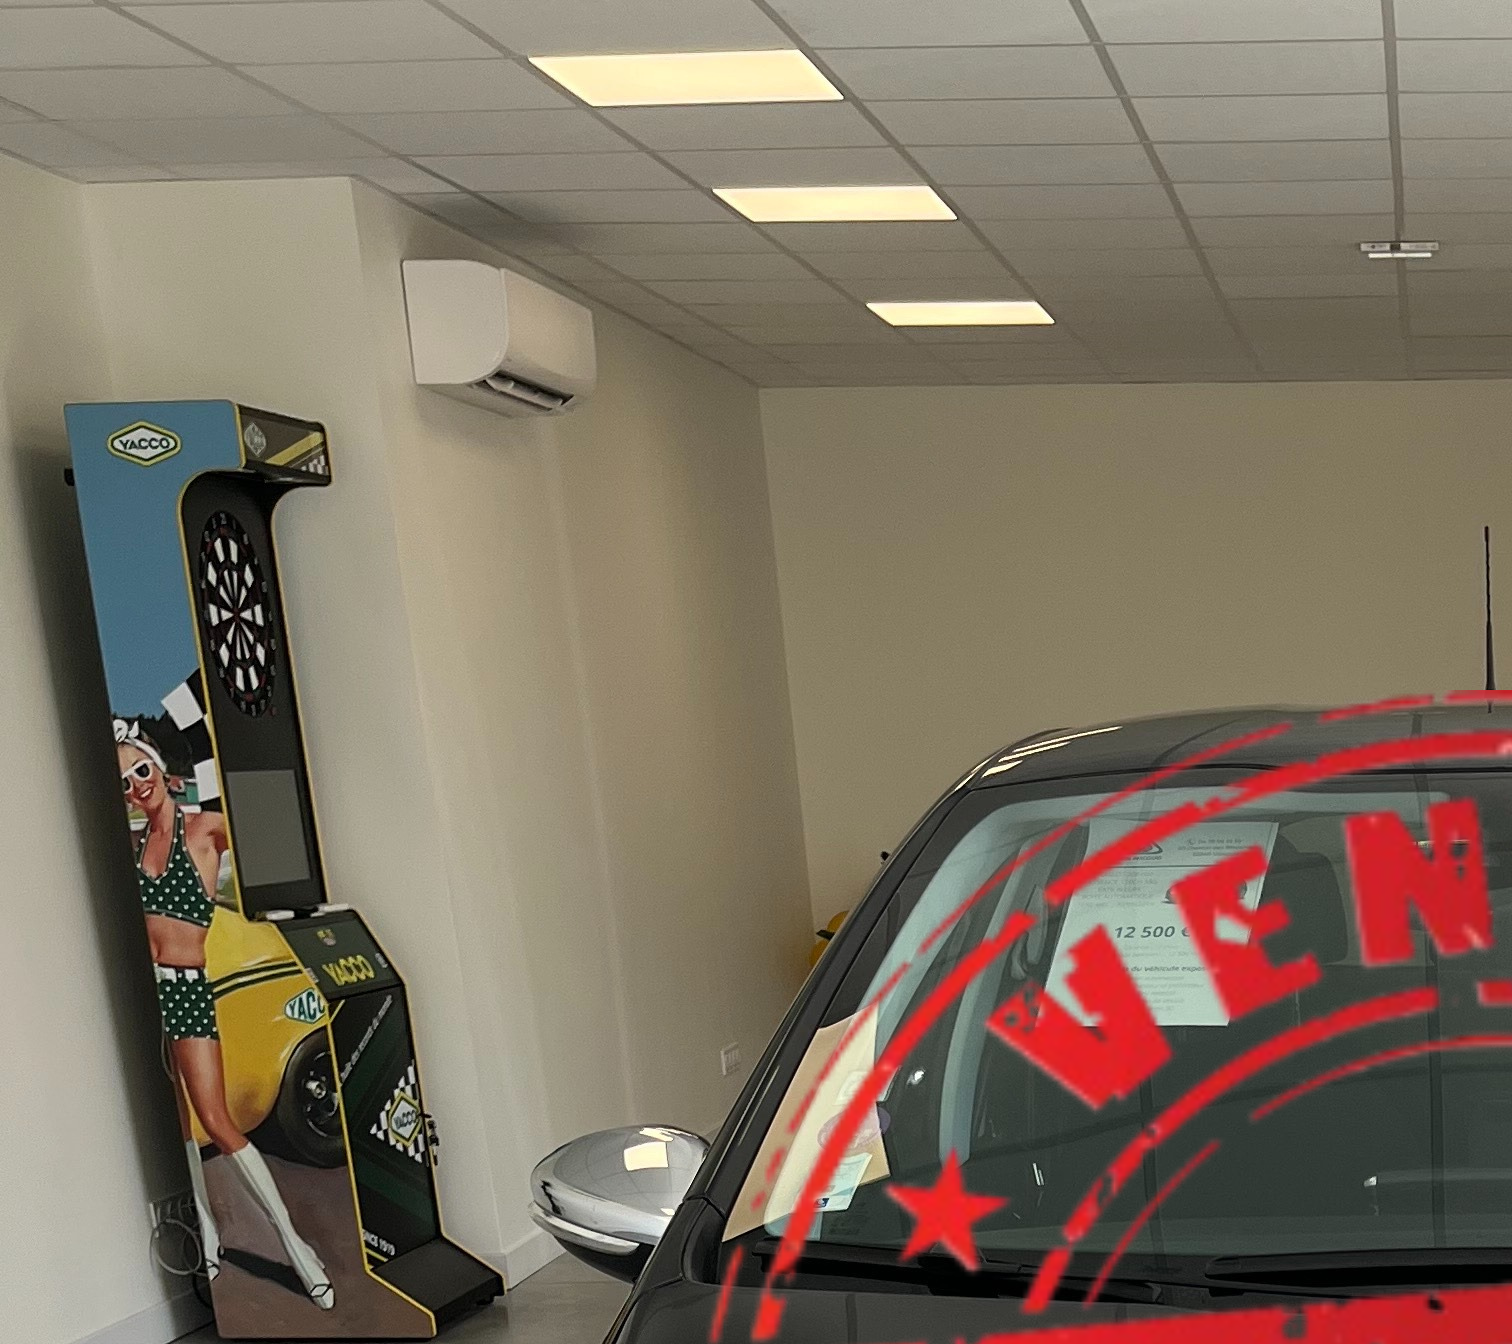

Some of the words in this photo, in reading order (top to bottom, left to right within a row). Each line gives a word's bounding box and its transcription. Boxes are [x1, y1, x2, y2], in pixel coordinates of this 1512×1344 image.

[119, 437, 170, 450] YACCO
[1115, 926, 1136, 938] 12
[1140, 926, 1176, 938] 500
[322, 955, 375, 987] YACCO
